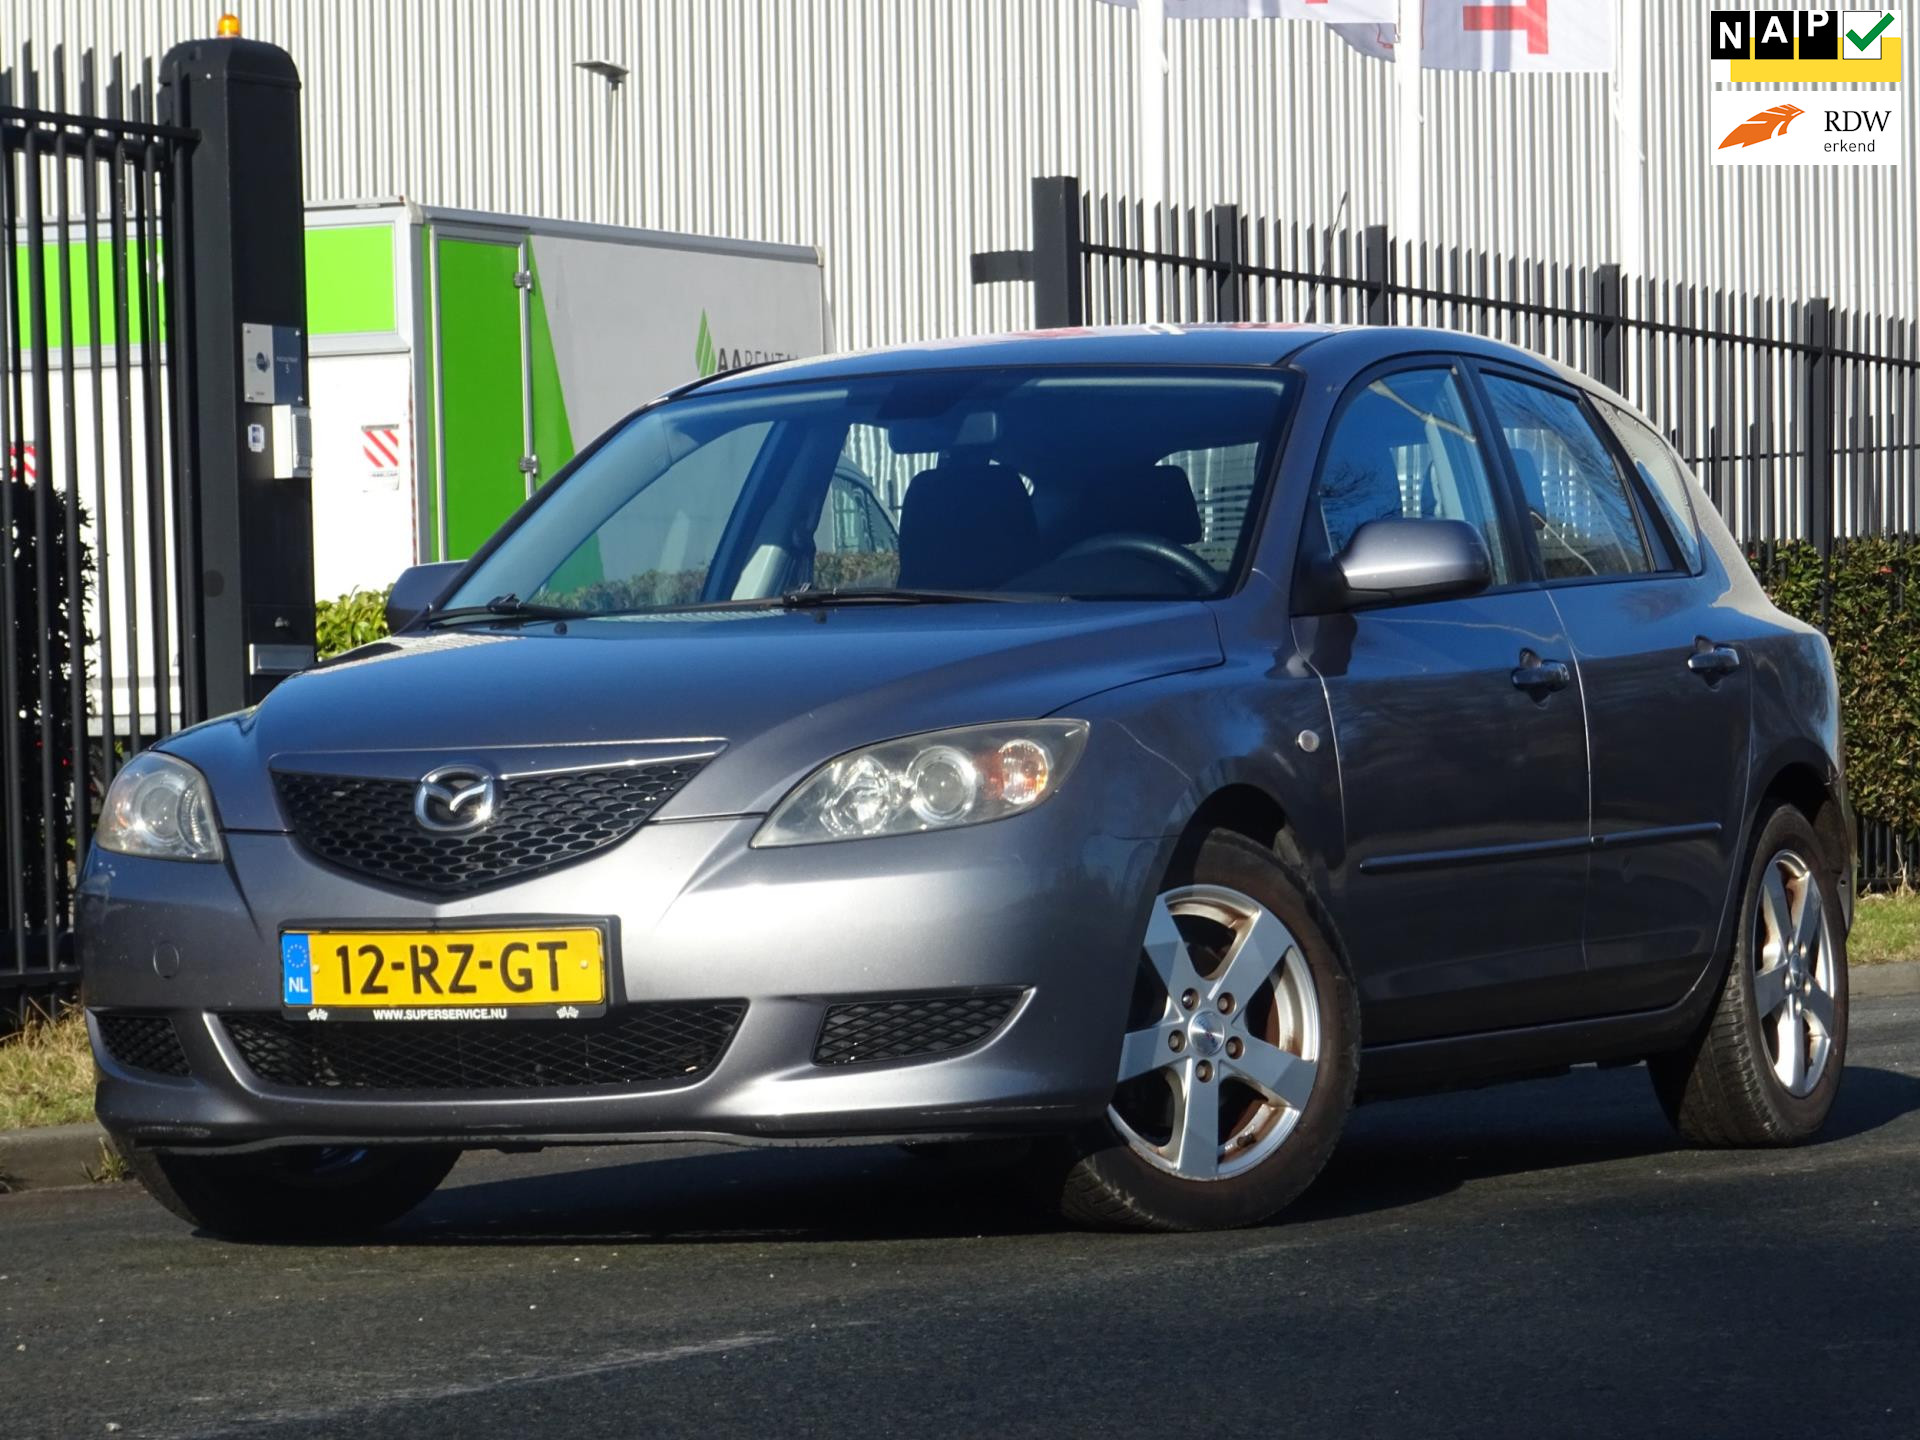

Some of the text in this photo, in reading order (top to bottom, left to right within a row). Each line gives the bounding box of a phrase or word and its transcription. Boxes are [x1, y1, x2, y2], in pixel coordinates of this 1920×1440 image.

[336, 941, 568, 995] 12-RZ-GT
[288, 977, 308, 993] NL
[373, 1008, 508, 1020] WWW.SUPERSERVICE.NU
